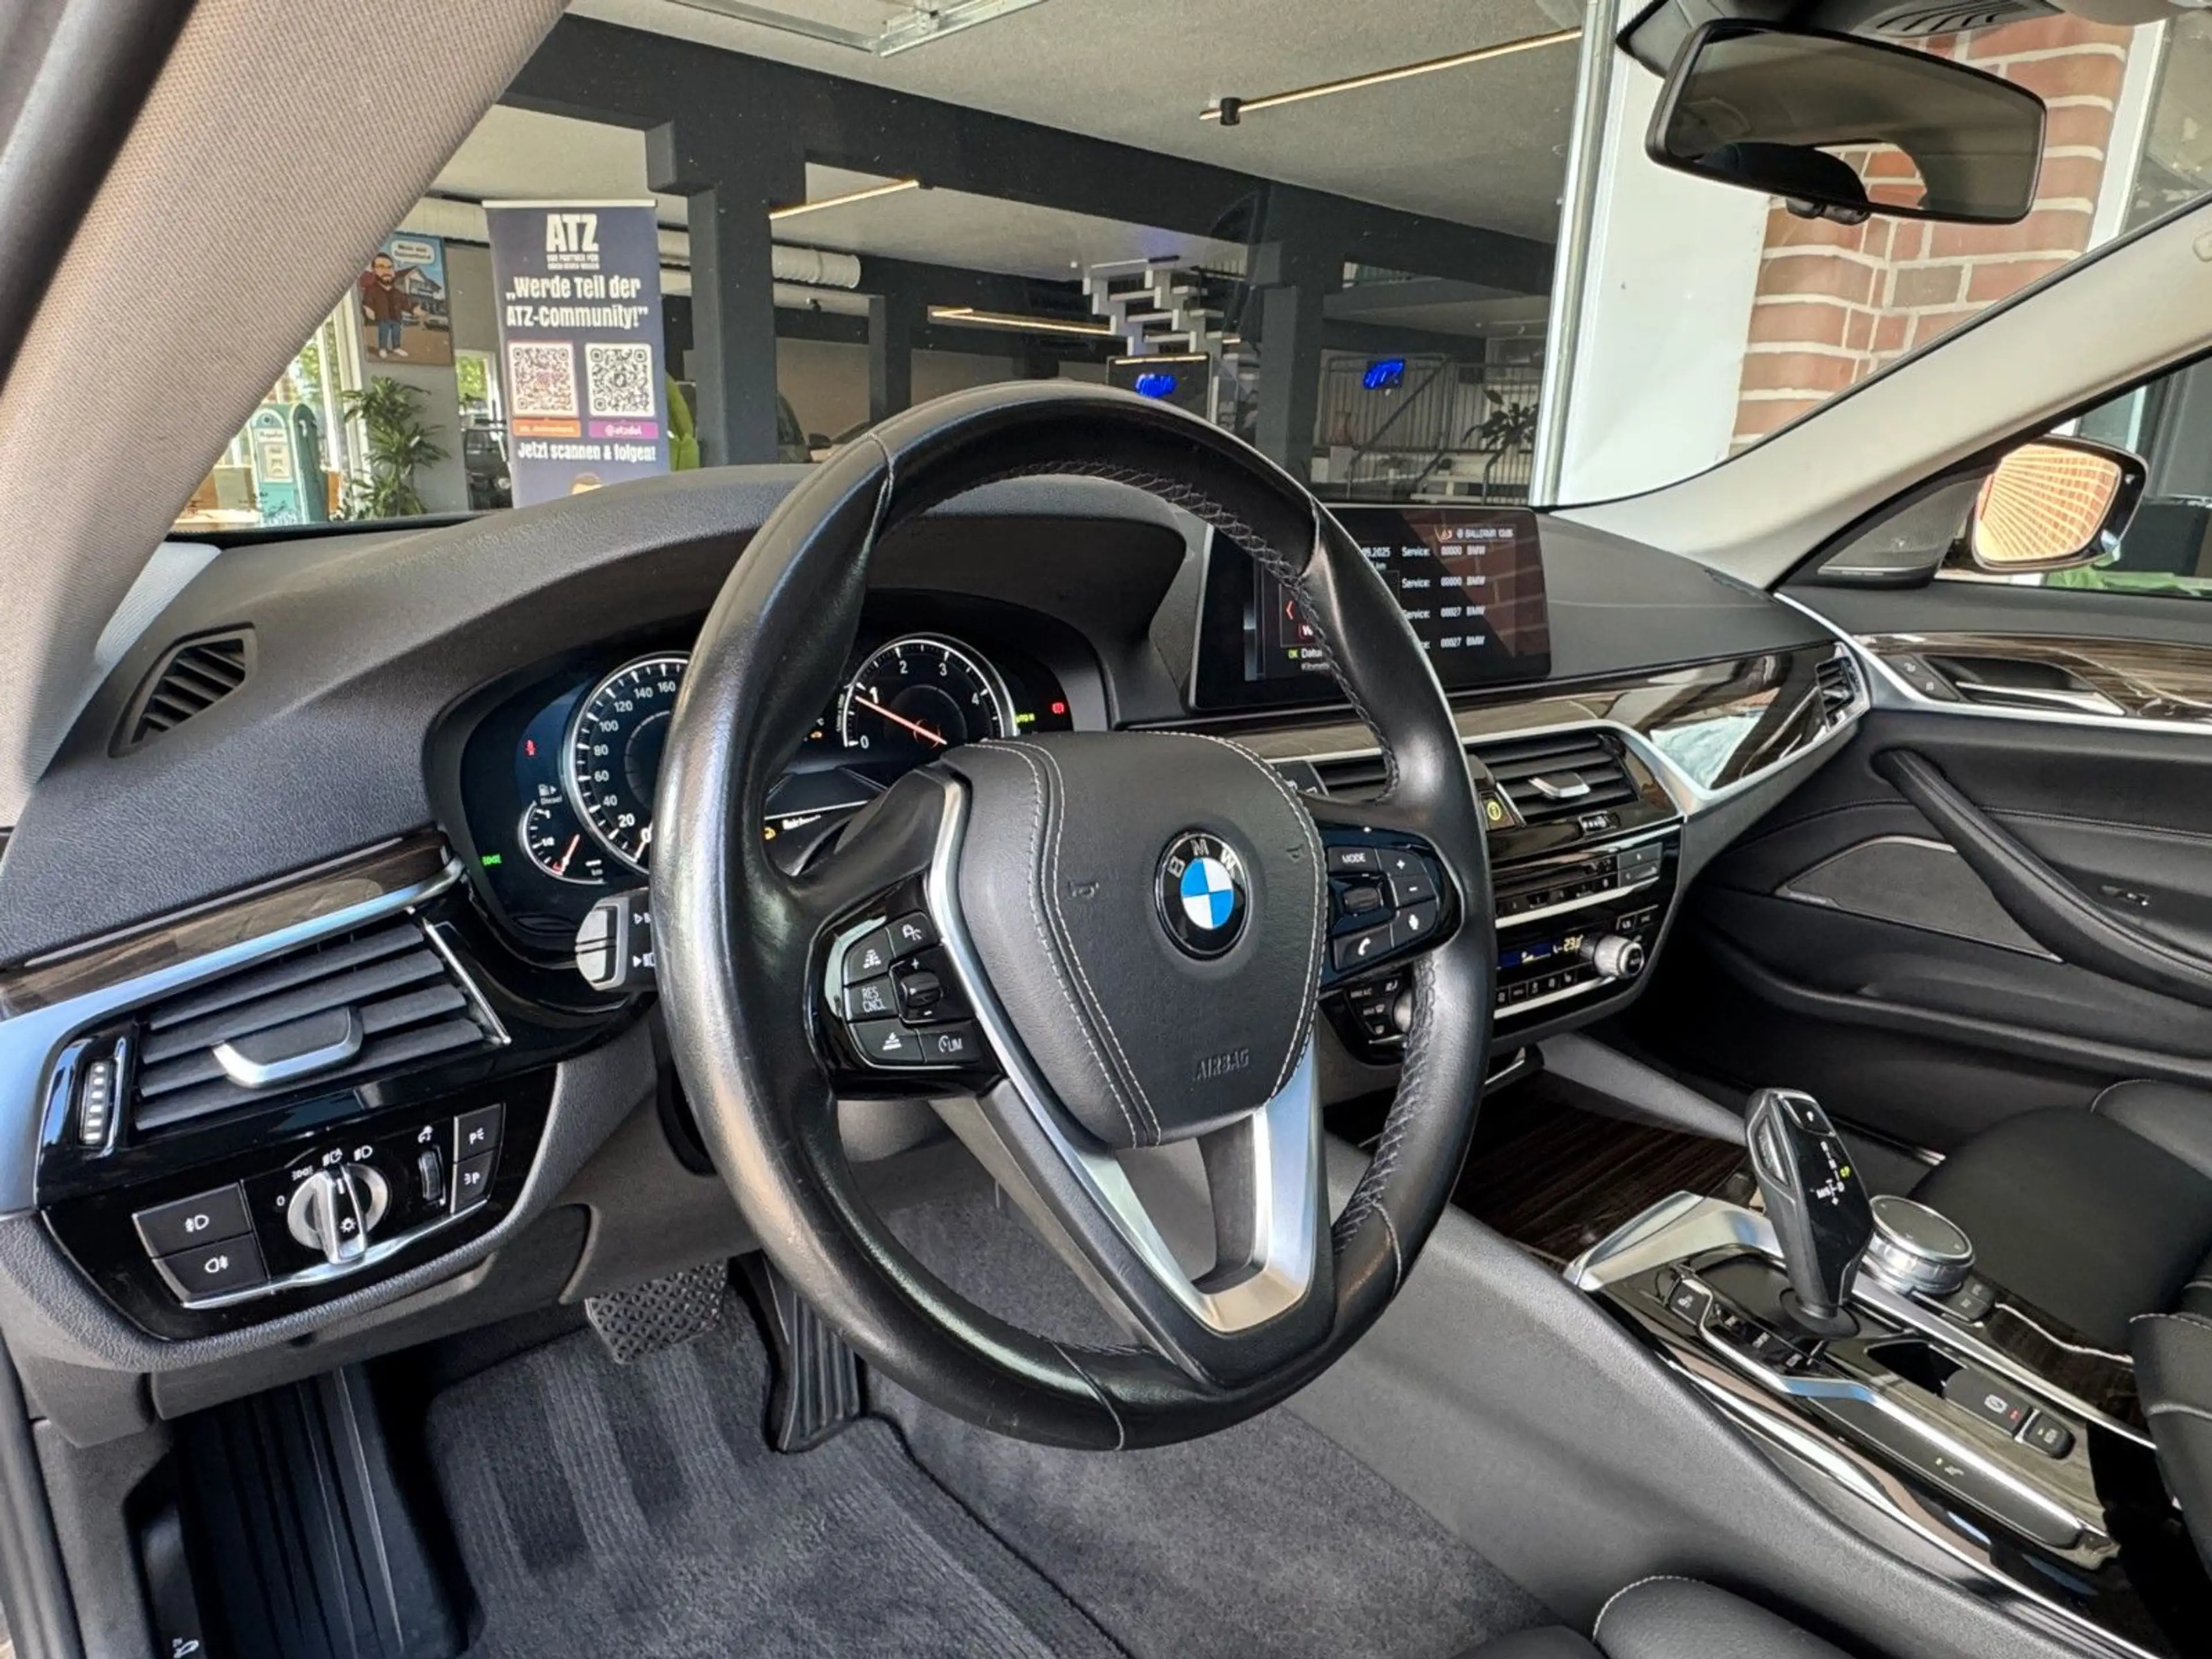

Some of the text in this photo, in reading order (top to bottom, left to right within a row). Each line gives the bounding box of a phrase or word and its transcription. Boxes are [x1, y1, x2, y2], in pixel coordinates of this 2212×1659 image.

[546, 213, 599, 252] ATZ
[574, 275, 605, 299] Teil
[609, 275, 641, 298] der
[518, 441, 548, 459] Jetzt
[551, 444, 600, 460] scannen
[613, 444, 656, 463] folgen!
[1467, 546, 1486, 555] BMW
[1467, 576, 1485, 585] BMW
[1466, 606, 1485, 616] BMW
[1466, 636, 1485, 646] BMW
[899, 660, 908, 675] 2
[938, 662, 948, 676] 3
[634, 687, 653, 699] 140
[657, 681, 676, 693] 160
[869, 687, 878, 704] 1
[972, 692, 980, 704] 4
[613, 700, 633, 713] 120
[599, 719, 619, 732] 100
[860, 734, 869, 749] 0
[594, 744, 609, 756] 80
[594, 770, 609, 782] 60
[603, 794, 618, 806] 40
[618, 813, 635, 828] 20
[641, 828, 652, 843] 0
[1168, 839, 1238, 880] BMW
[1342, 854, 1366, 863] MODE
[861, 986, 879, 998] RES
[1195, 1047, 1250, 1081] AIRBAG
